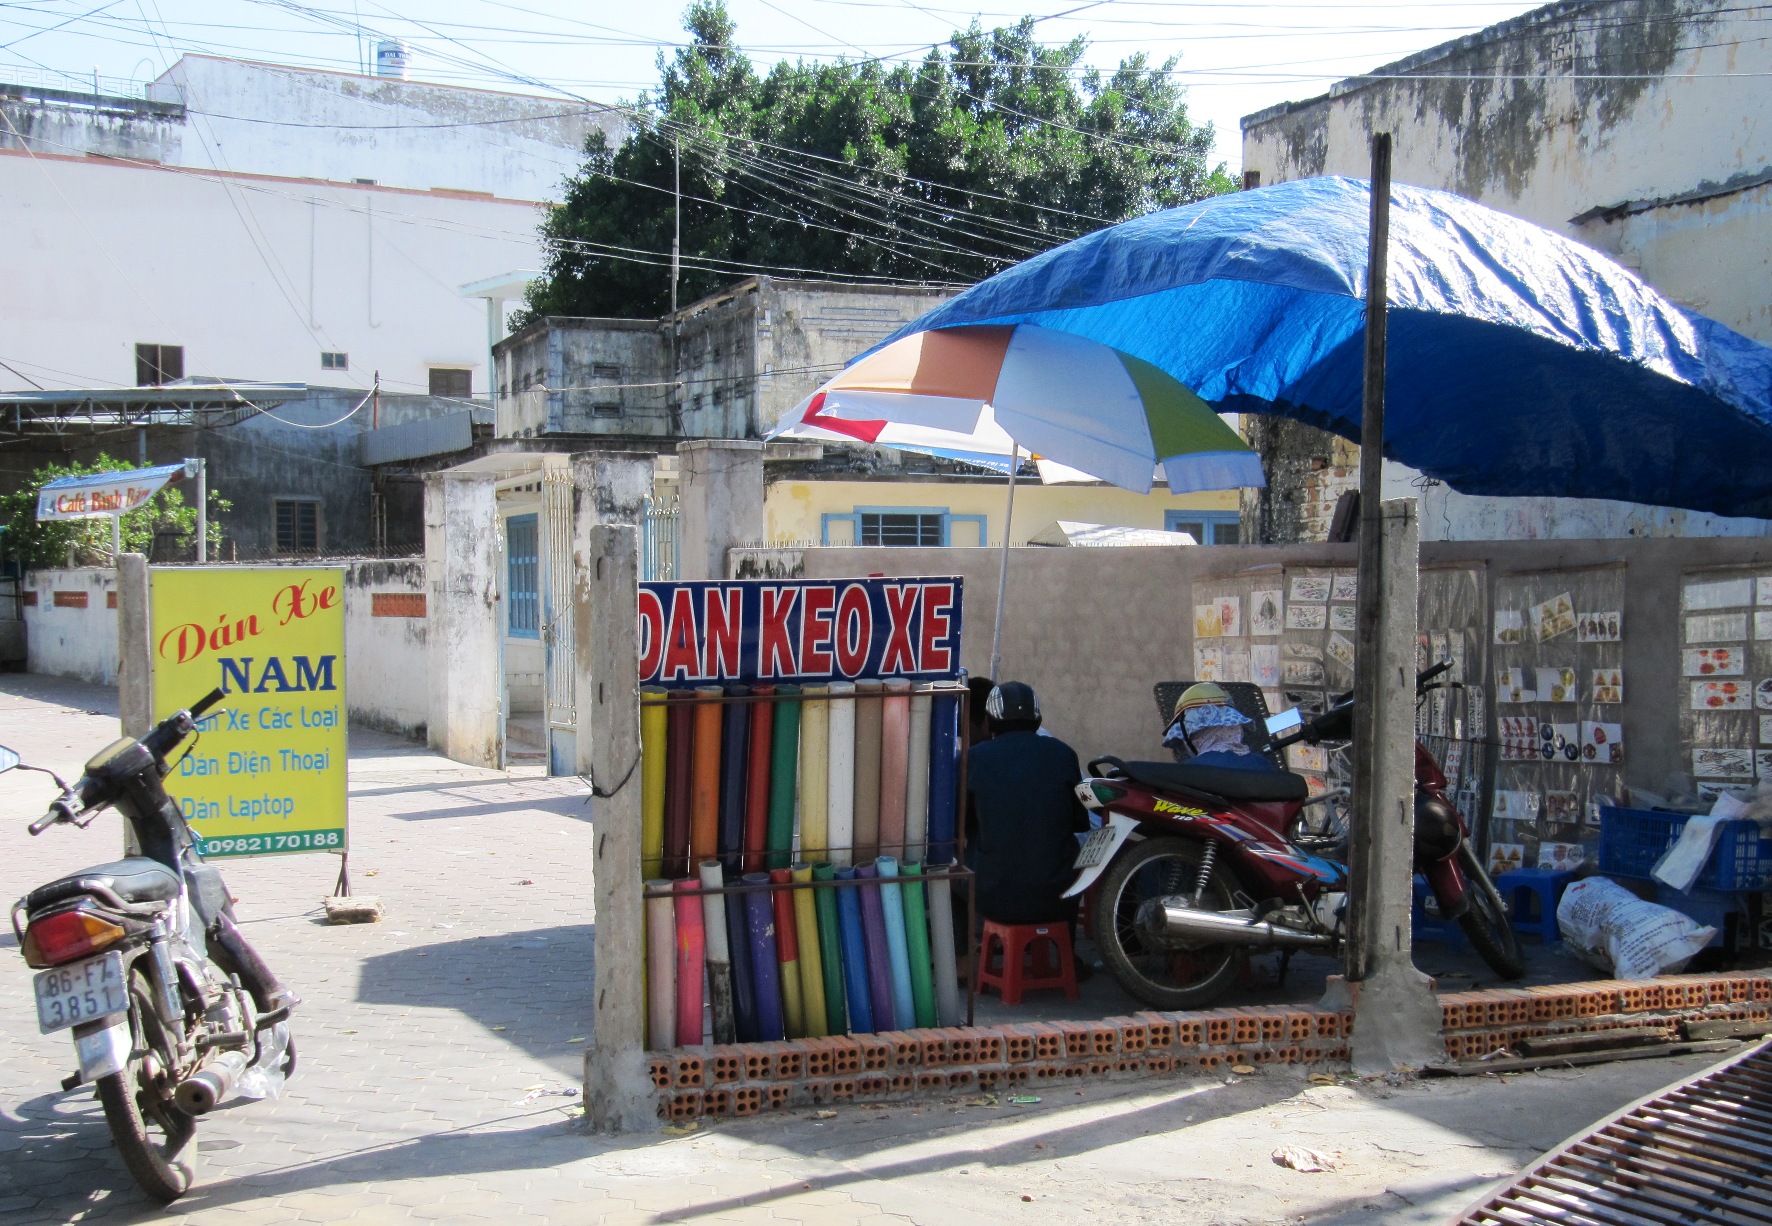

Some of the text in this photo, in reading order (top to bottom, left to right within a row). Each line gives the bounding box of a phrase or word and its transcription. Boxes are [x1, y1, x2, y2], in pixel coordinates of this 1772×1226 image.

[57, 492, 85, 513] Café
[159, 578, 342, 665] Dán Xe
[639, 583, 954, 681] DAN KEO XE
[217, 655, 337, 694] NAM
[227, 708, 250, 731] Xe
[258, 706, 294, 730] Các
[300, 705, 339, 732] Loại
[180, 748, 330, 778] Dán Điện Thoại
[181, 794, 295, 821] Dán Laptop
[1153, 800, 1209, 816] Wave
[208, 832, 339, 853] 0982170188
[52, 987, 112, 1024] 3851
